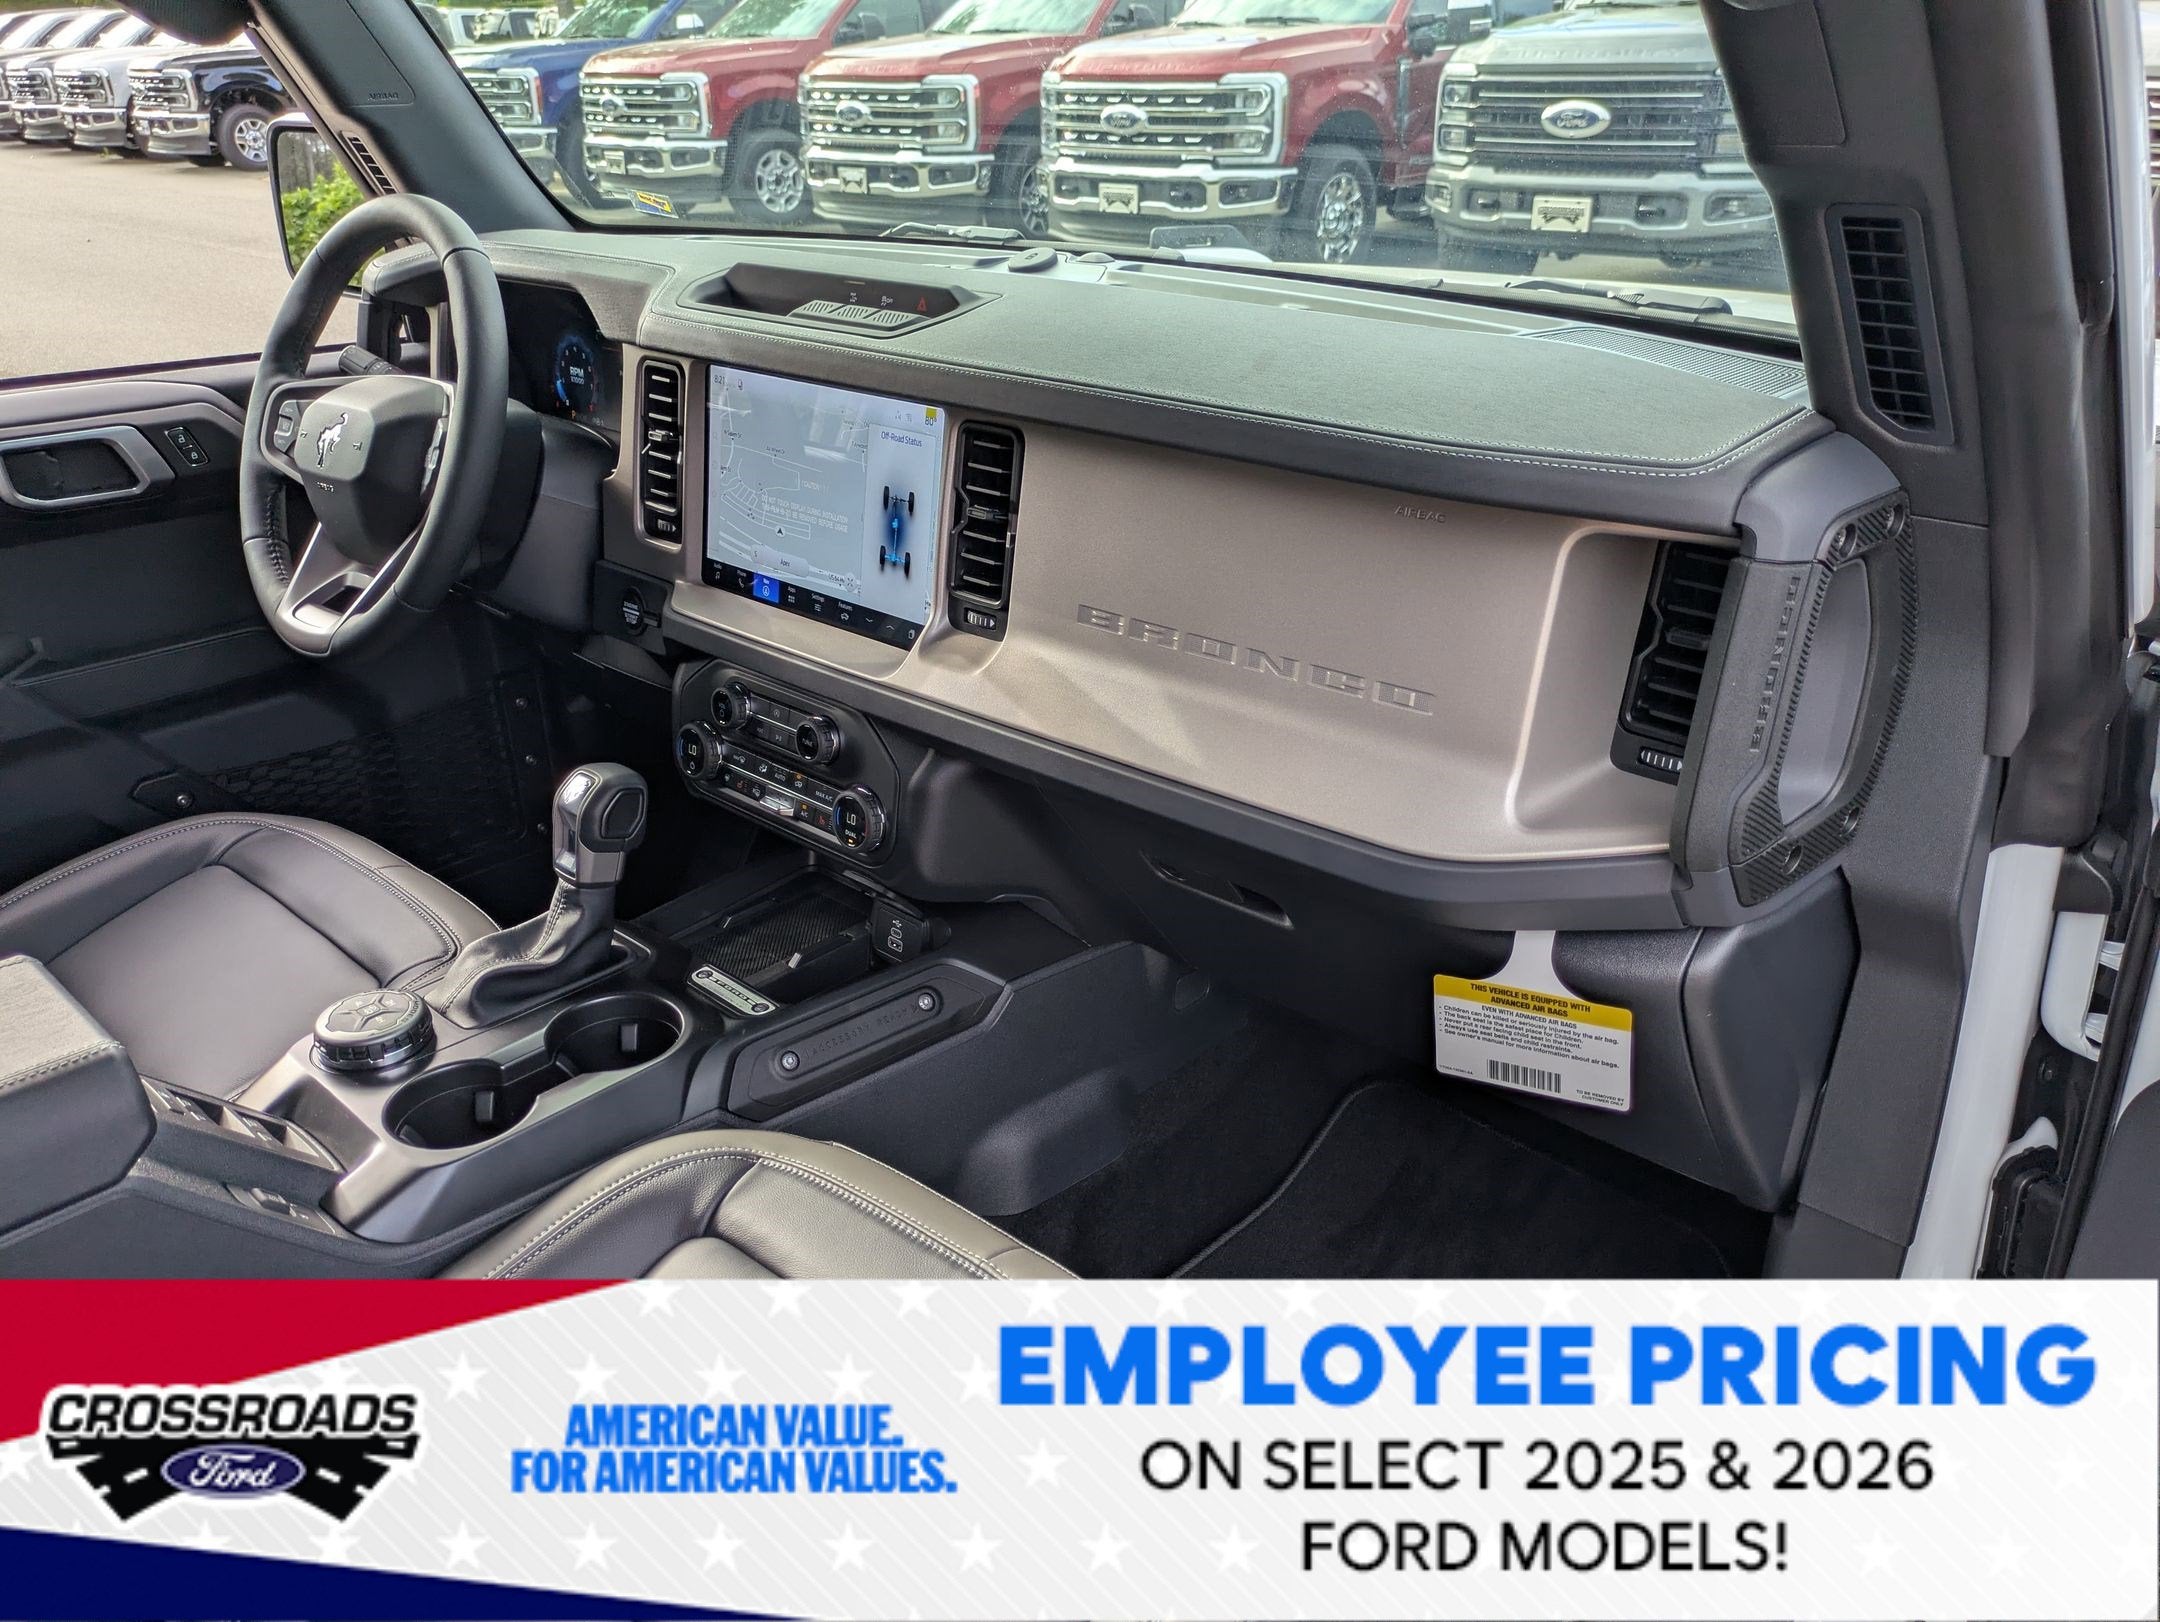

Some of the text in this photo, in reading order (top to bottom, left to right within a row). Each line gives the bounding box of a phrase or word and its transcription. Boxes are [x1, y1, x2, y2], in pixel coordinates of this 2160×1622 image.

[569, 366, 584, 378] RPM
[880, 430, 905, 445] Off-Road
[904, 436, 923, 448] Status
[1393, 504, 1448, 524] AIRBAG
[1076, 603, 1437, 716] BRONCO
[1470, 983, 1591, 1013] THIS VEHICLE IS EQUIPPED WITH
[1490, 996, 1569, 1018] ADVANCED AIR BAGS
[1443, 1005, 1470, 1014] Children
[1518, 1020, 1548, 1030] seriously
[1549, 1026, 1572, 1035] injured
[1481, 1005, 1577, 1030] EVEN WITH ADVANCED AIR BAGS
[1444, 1017, 1462, 1025] Never
[1463, 1020, 1473, 1028] put
[1493, 1026, 1512, 1035] facing
[1513, 1030, 1529, 1038] child
[1564, 1041, 1582, 1049] front.
[1444, 1022, 1466, 1031] Always
[1523, 1038, 1539, 1046] child
[1525, 1027, 1543, 1035] place
[1533, 1047, 1570, 1059] information
[1570, 1055, 1590, 1063] about
[1601, 1060, 1620, 1069] bags.
